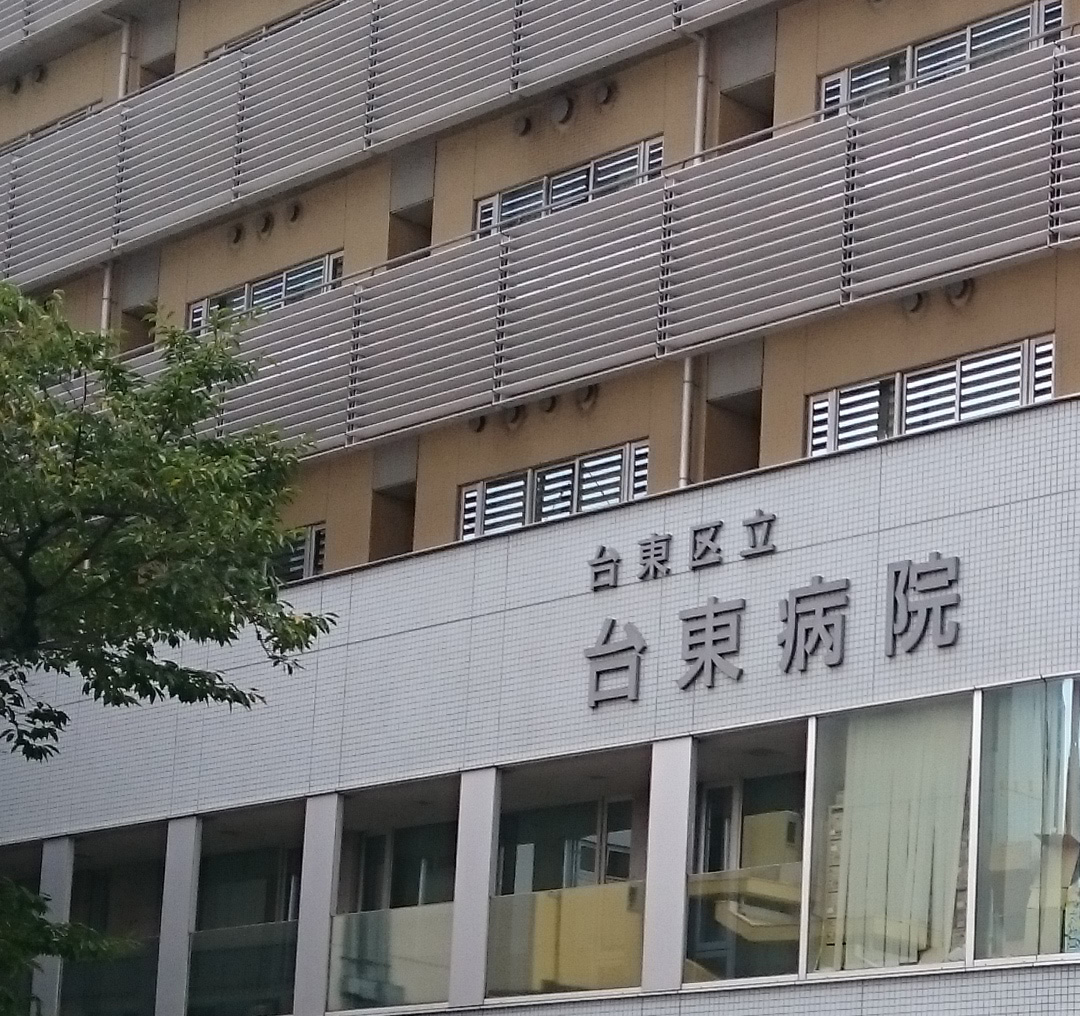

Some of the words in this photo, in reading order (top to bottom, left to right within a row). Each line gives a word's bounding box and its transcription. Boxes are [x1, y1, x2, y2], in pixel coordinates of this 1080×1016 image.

[587, 508, 778, 592] 台東区立
[583, 550, 961, 710] 台東病院
